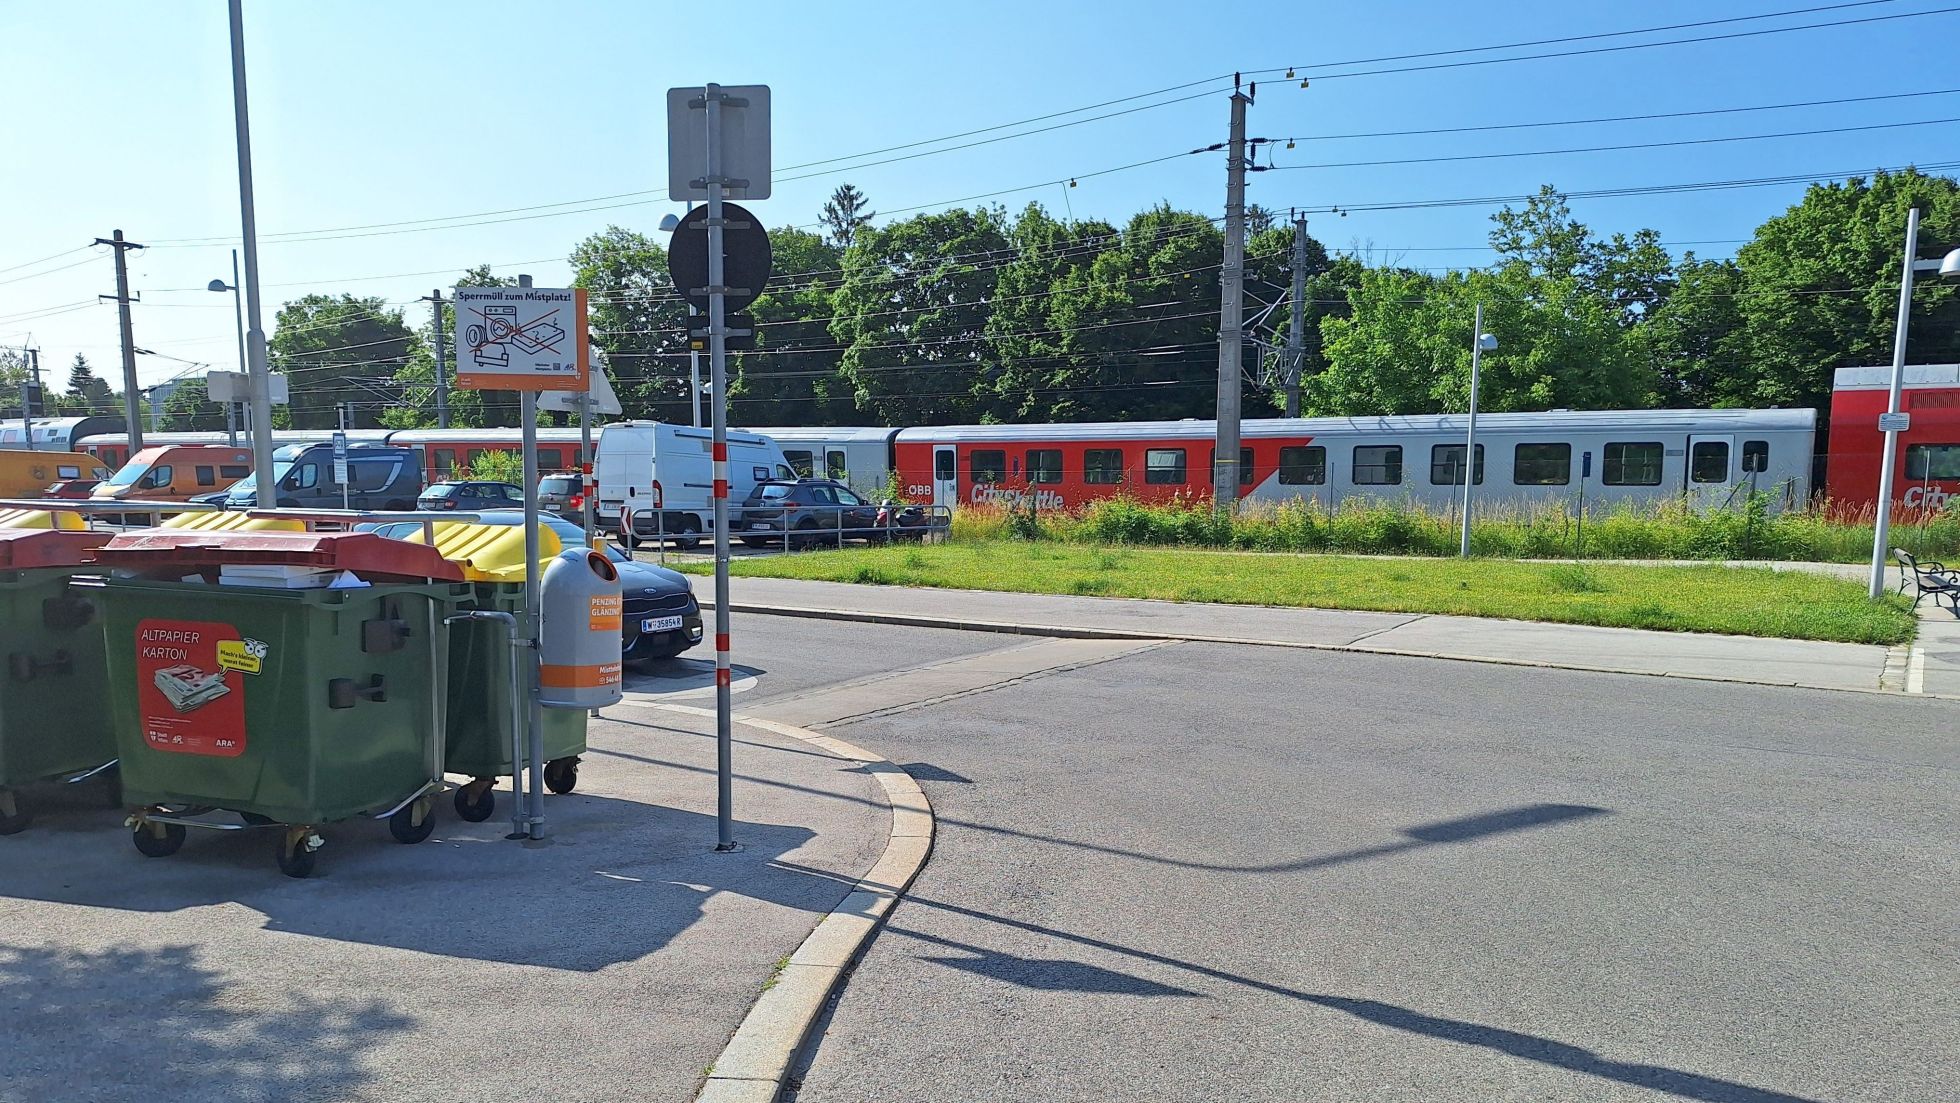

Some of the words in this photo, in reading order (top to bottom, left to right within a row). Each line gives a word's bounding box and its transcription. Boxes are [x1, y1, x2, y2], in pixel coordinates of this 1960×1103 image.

[459, 292, 503, 302] Sperrmüll
[525, 291, 571, 303] Mistplatz!
[141, 629, 200, 644] ALTPAPIER
[142, 646, 188, 661] KARTON
